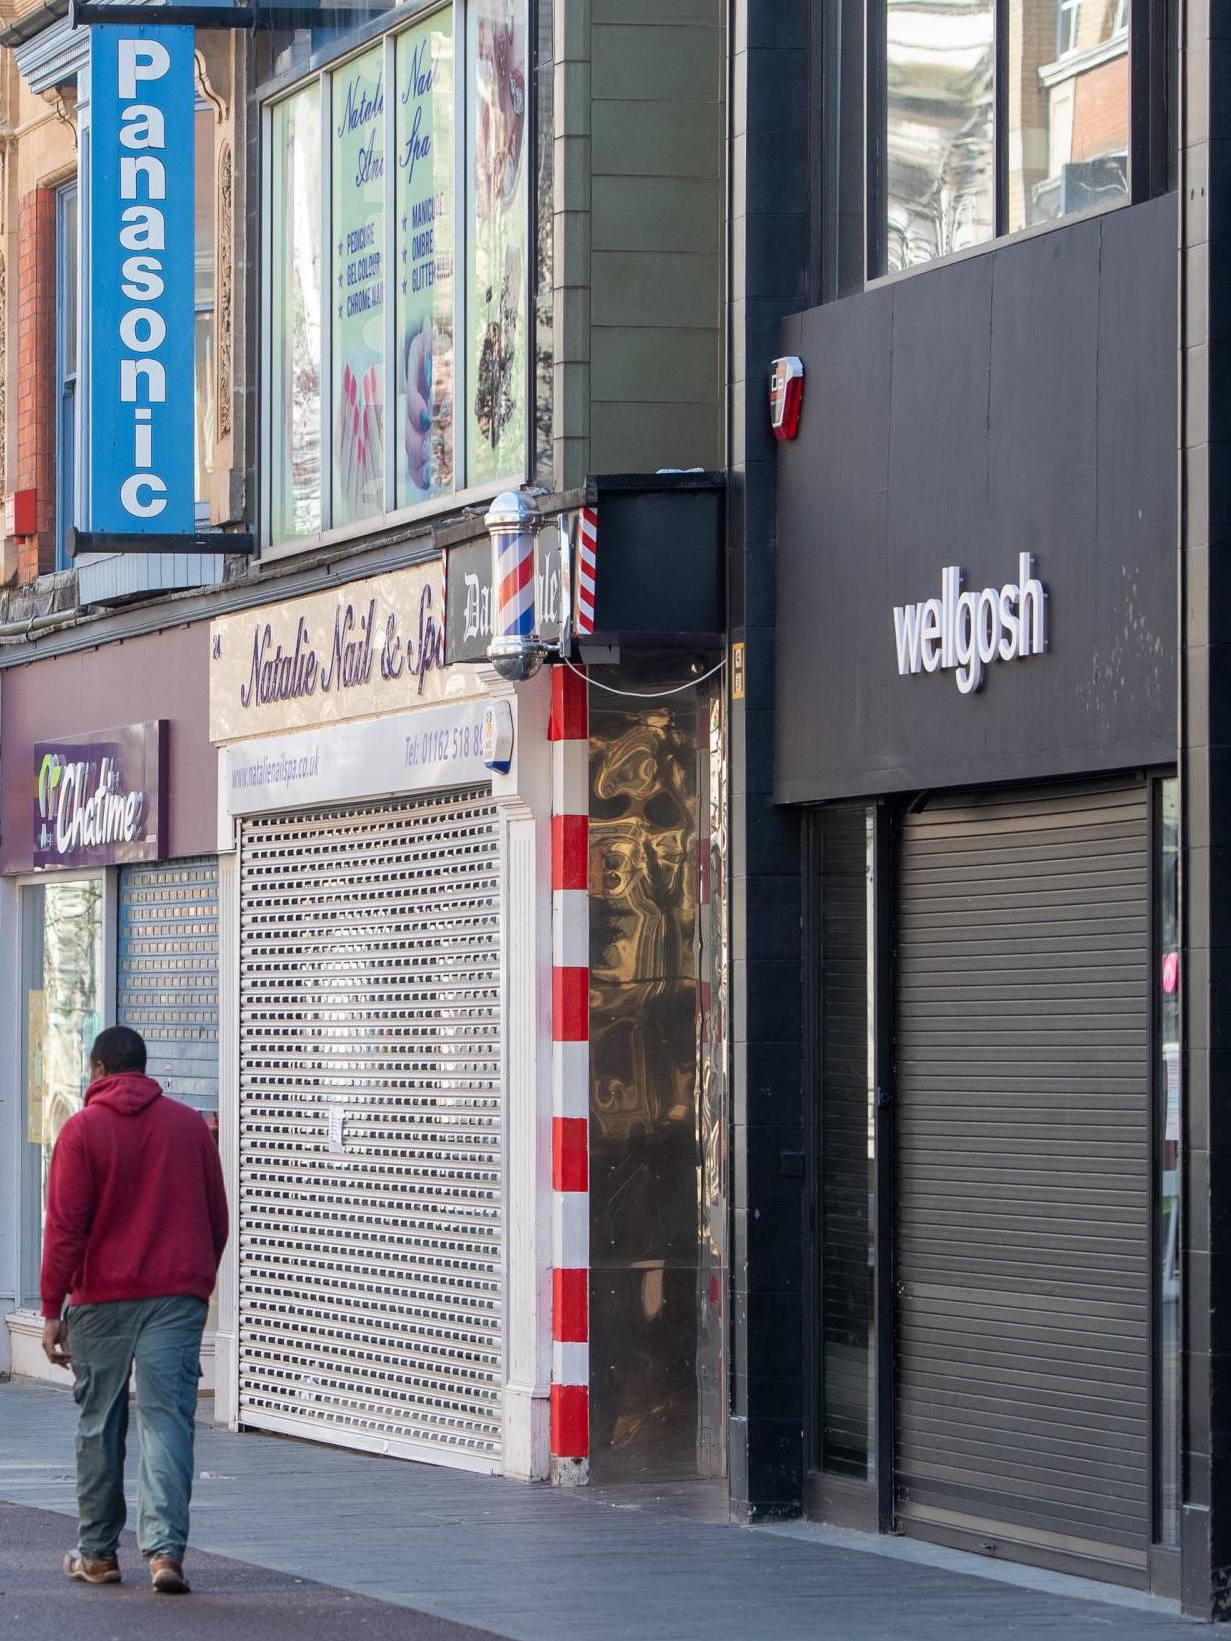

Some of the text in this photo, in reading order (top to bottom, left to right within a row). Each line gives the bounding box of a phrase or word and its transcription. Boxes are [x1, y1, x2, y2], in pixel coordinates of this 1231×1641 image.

[399, 105, 432, 184] Spa
[347, 222, 374, 256] PEDICURE
[412, 229, 433, 261] OMBRE
[118, 39, 171, 518] Panasonic
[347, 287, 370, 317] CHROME
[241, 615, 318, 708] Natalie
[321, 598, 376, 692] Nail
[381, 612, 403, 680] &
[893, 552, 1045, 694] wellgosh
[231, 745, 319, 790] www.natalienailspa.co.uk
[405, 733, 418, 768] Tel:
[421, 729, 449, 764] 01162
[452, 726, 470, 760] 518
[56, 757, 140, 854] Chatime
